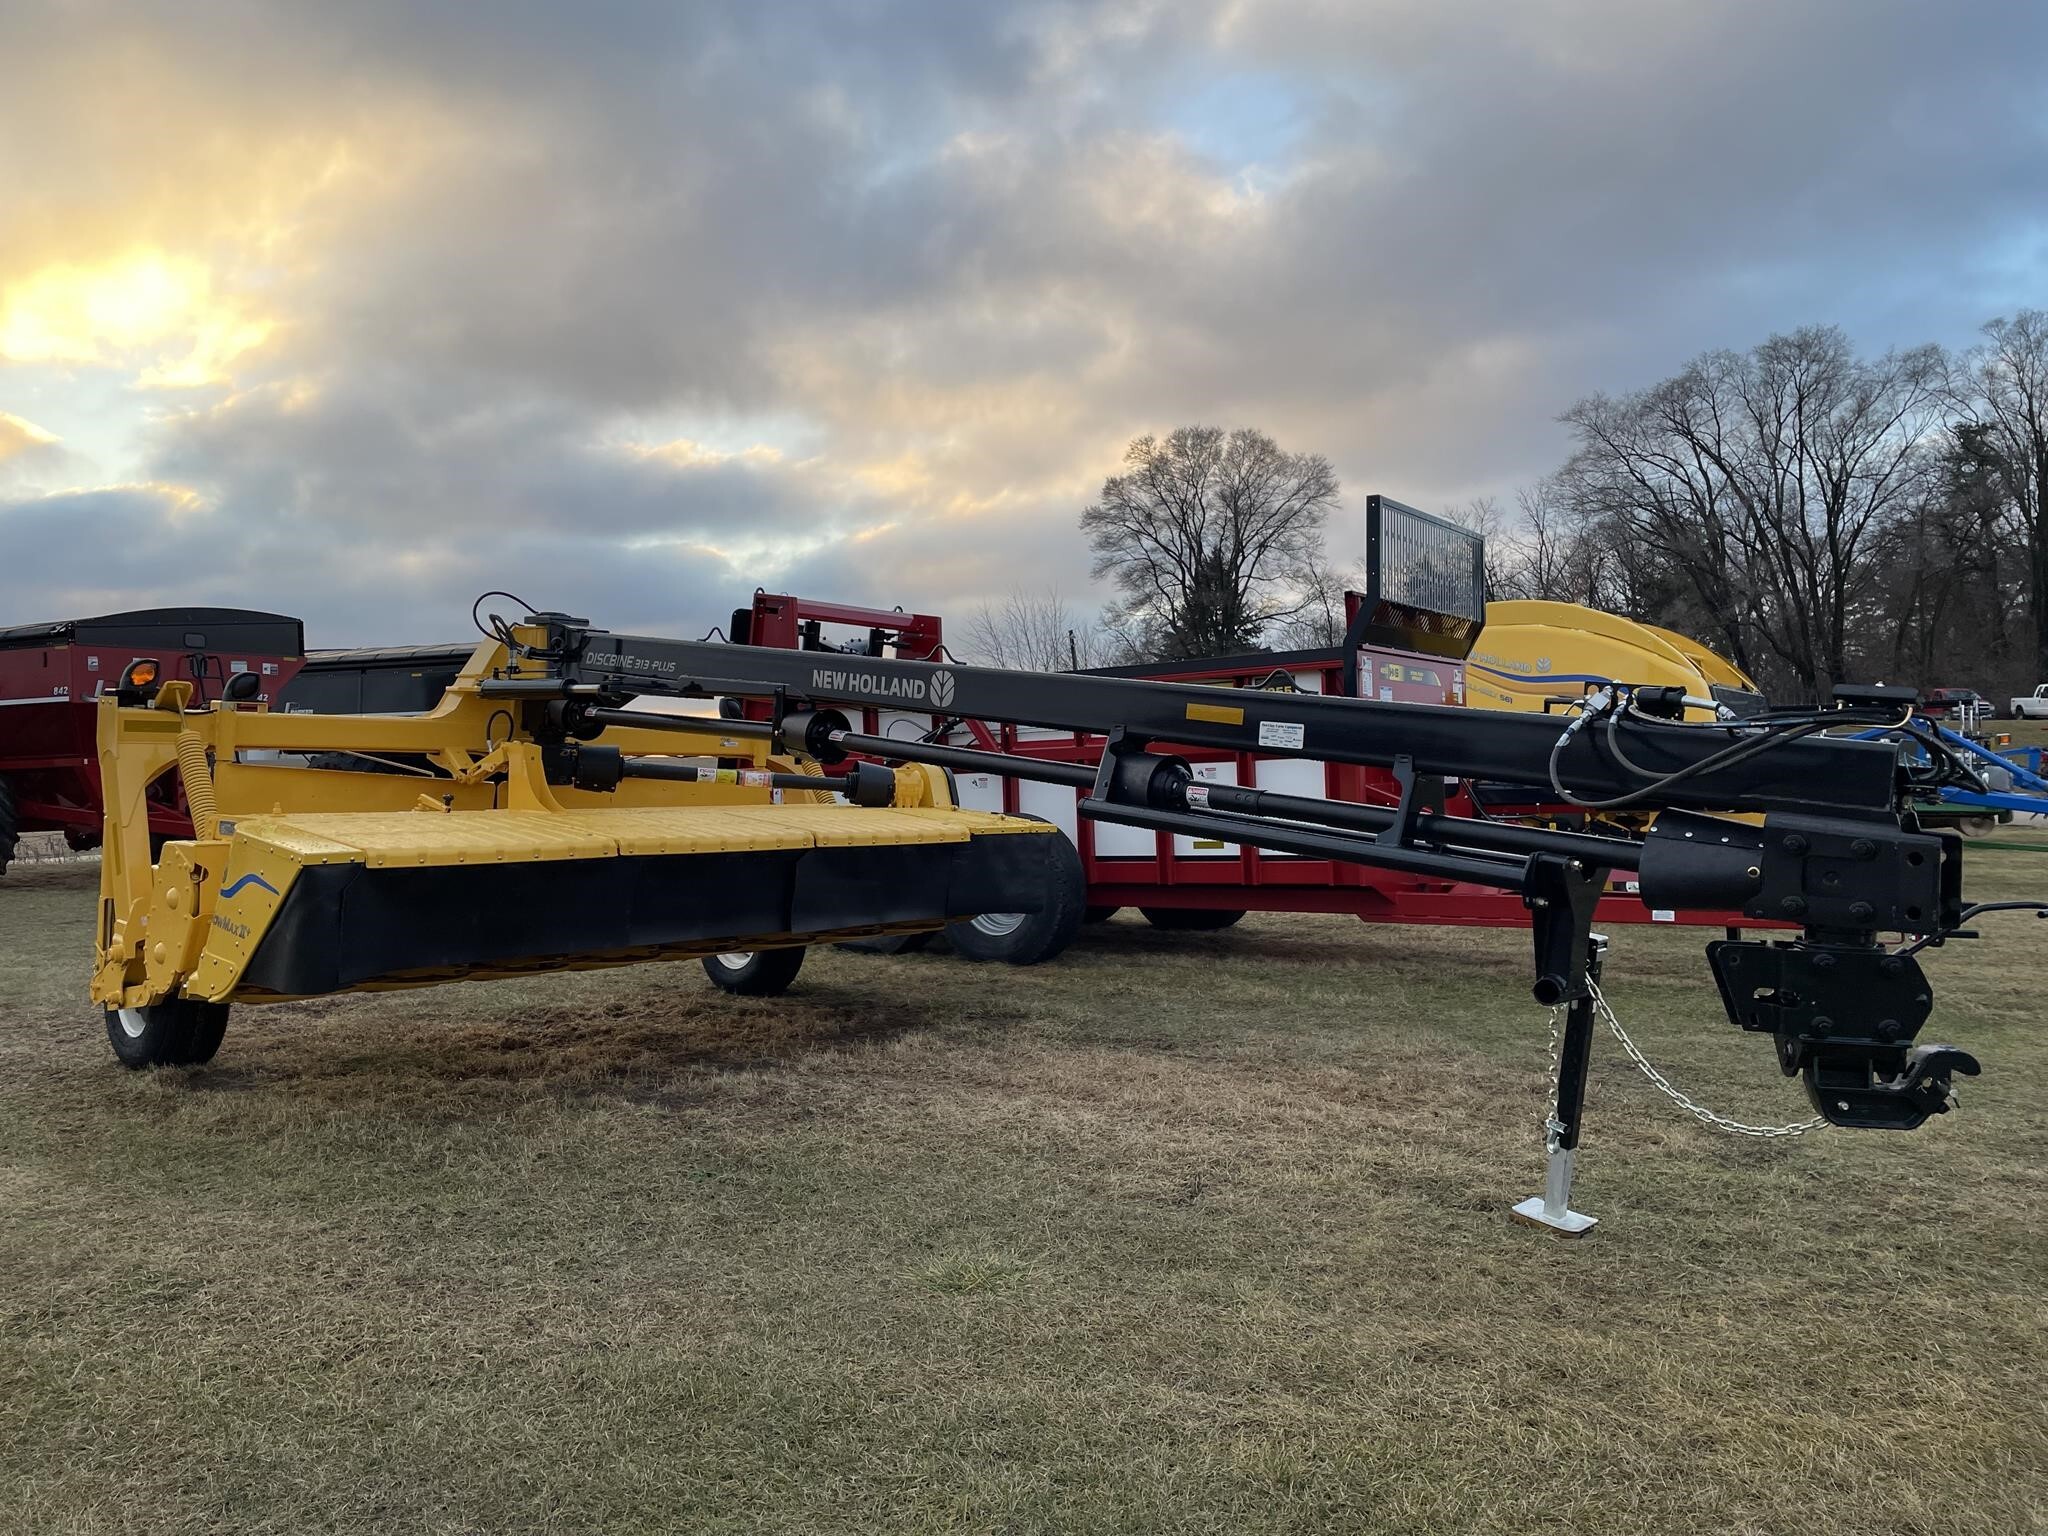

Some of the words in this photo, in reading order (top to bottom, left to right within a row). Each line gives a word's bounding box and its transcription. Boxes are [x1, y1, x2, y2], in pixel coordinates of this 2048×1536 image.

[586, 652, 634, 668] DISCBINE
[634, 659, 650, 670] 313
[53, 686, 69, 696] 842
[812, 669, 847, 690] NEW
[848, 673, 926, 699] HOLLAND
